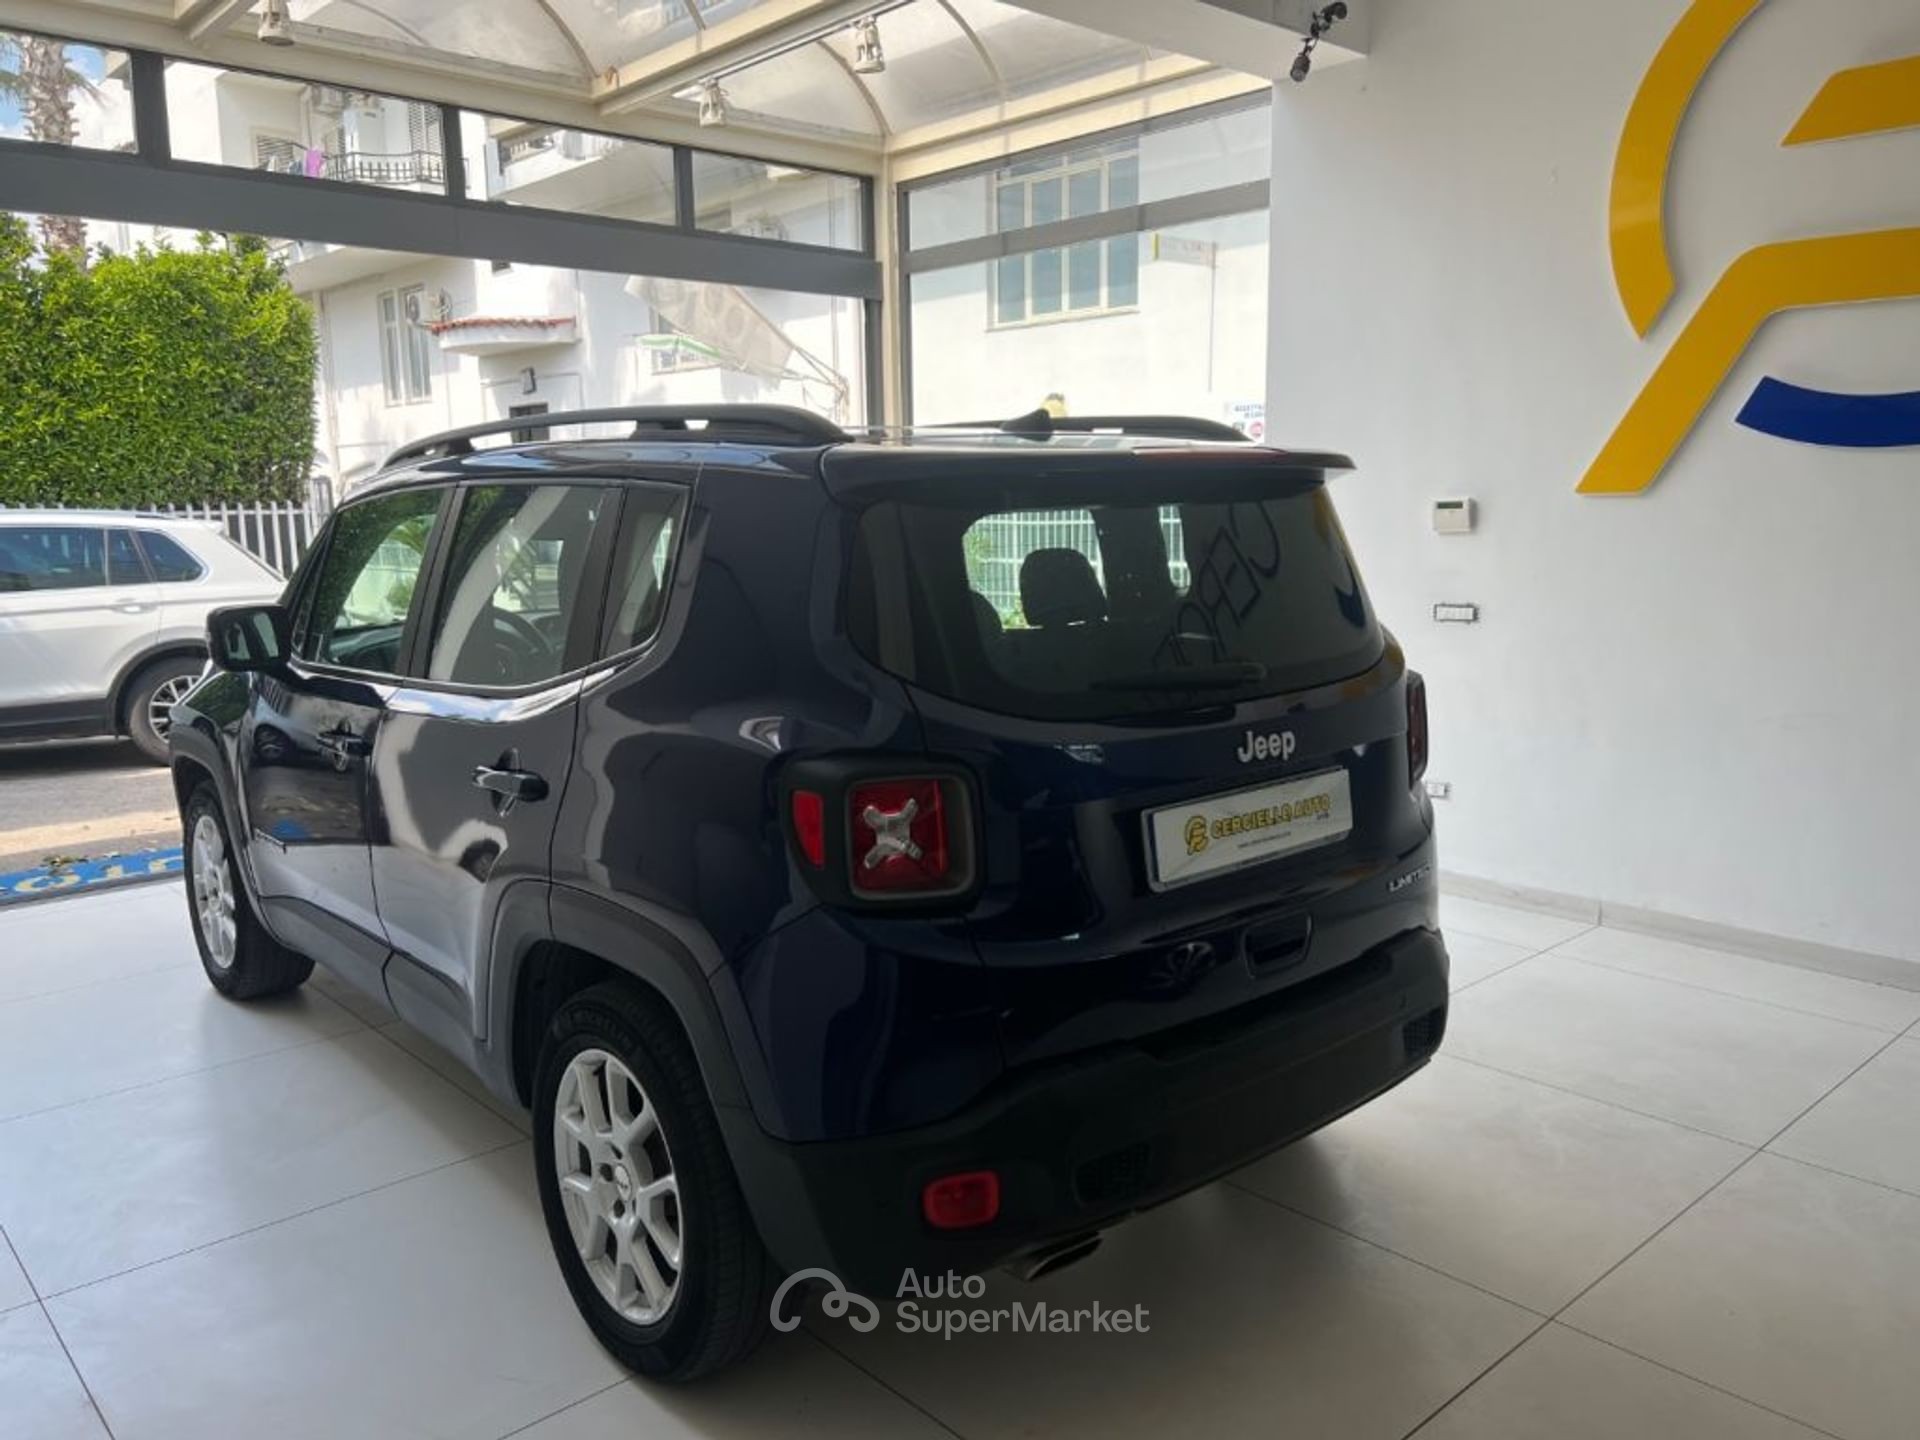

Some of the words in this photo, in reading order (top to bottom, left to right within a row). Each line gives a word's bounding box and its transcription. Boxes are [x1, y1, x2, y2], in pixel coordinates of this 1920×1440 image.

[1236, 730, 1296, 763] Jeep
[1210, 802, 1293, 839] CERCIELLO
[1294, 792, 1330, 817] AUTO
